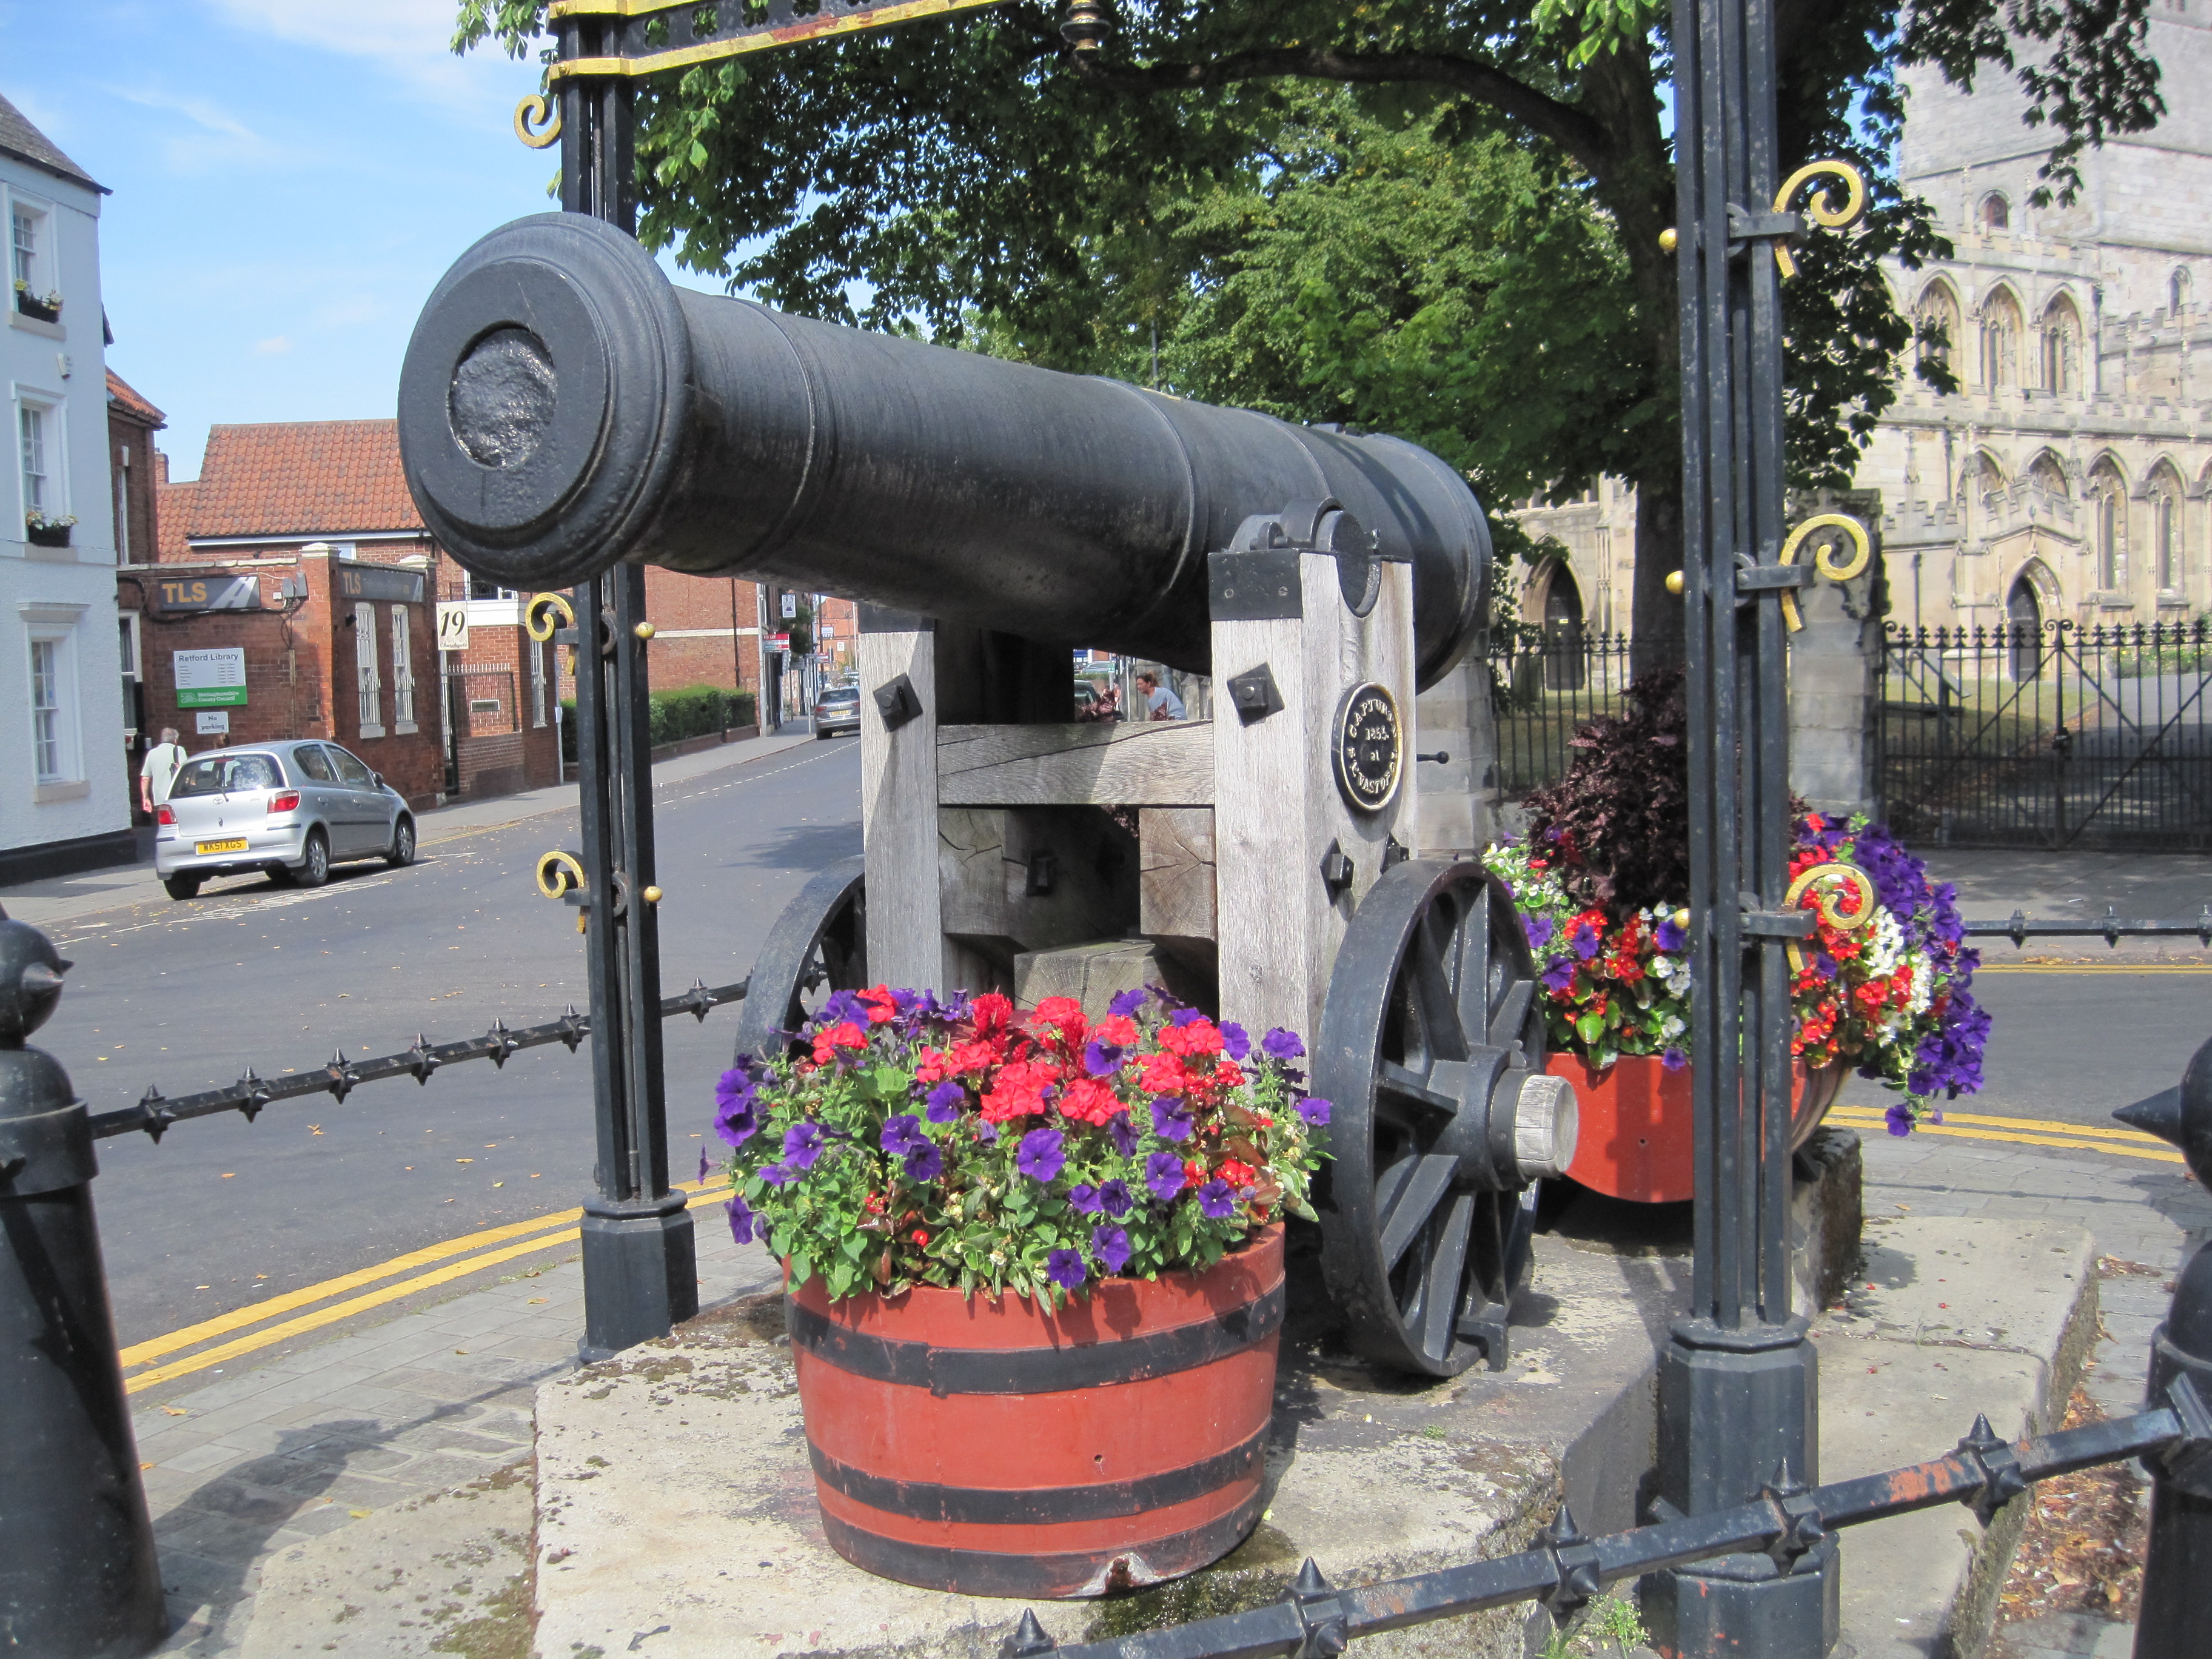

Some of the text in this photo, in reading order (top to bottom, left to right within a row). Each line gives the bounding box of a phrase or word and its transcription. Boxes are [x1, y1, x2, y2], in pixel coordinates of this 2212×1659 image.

[163, 582, 207, 603] TLS
[343, 572, 361, 594] TLS
[441, 611, 465, 636] 19
[224, 840, 242, 850] XGS
